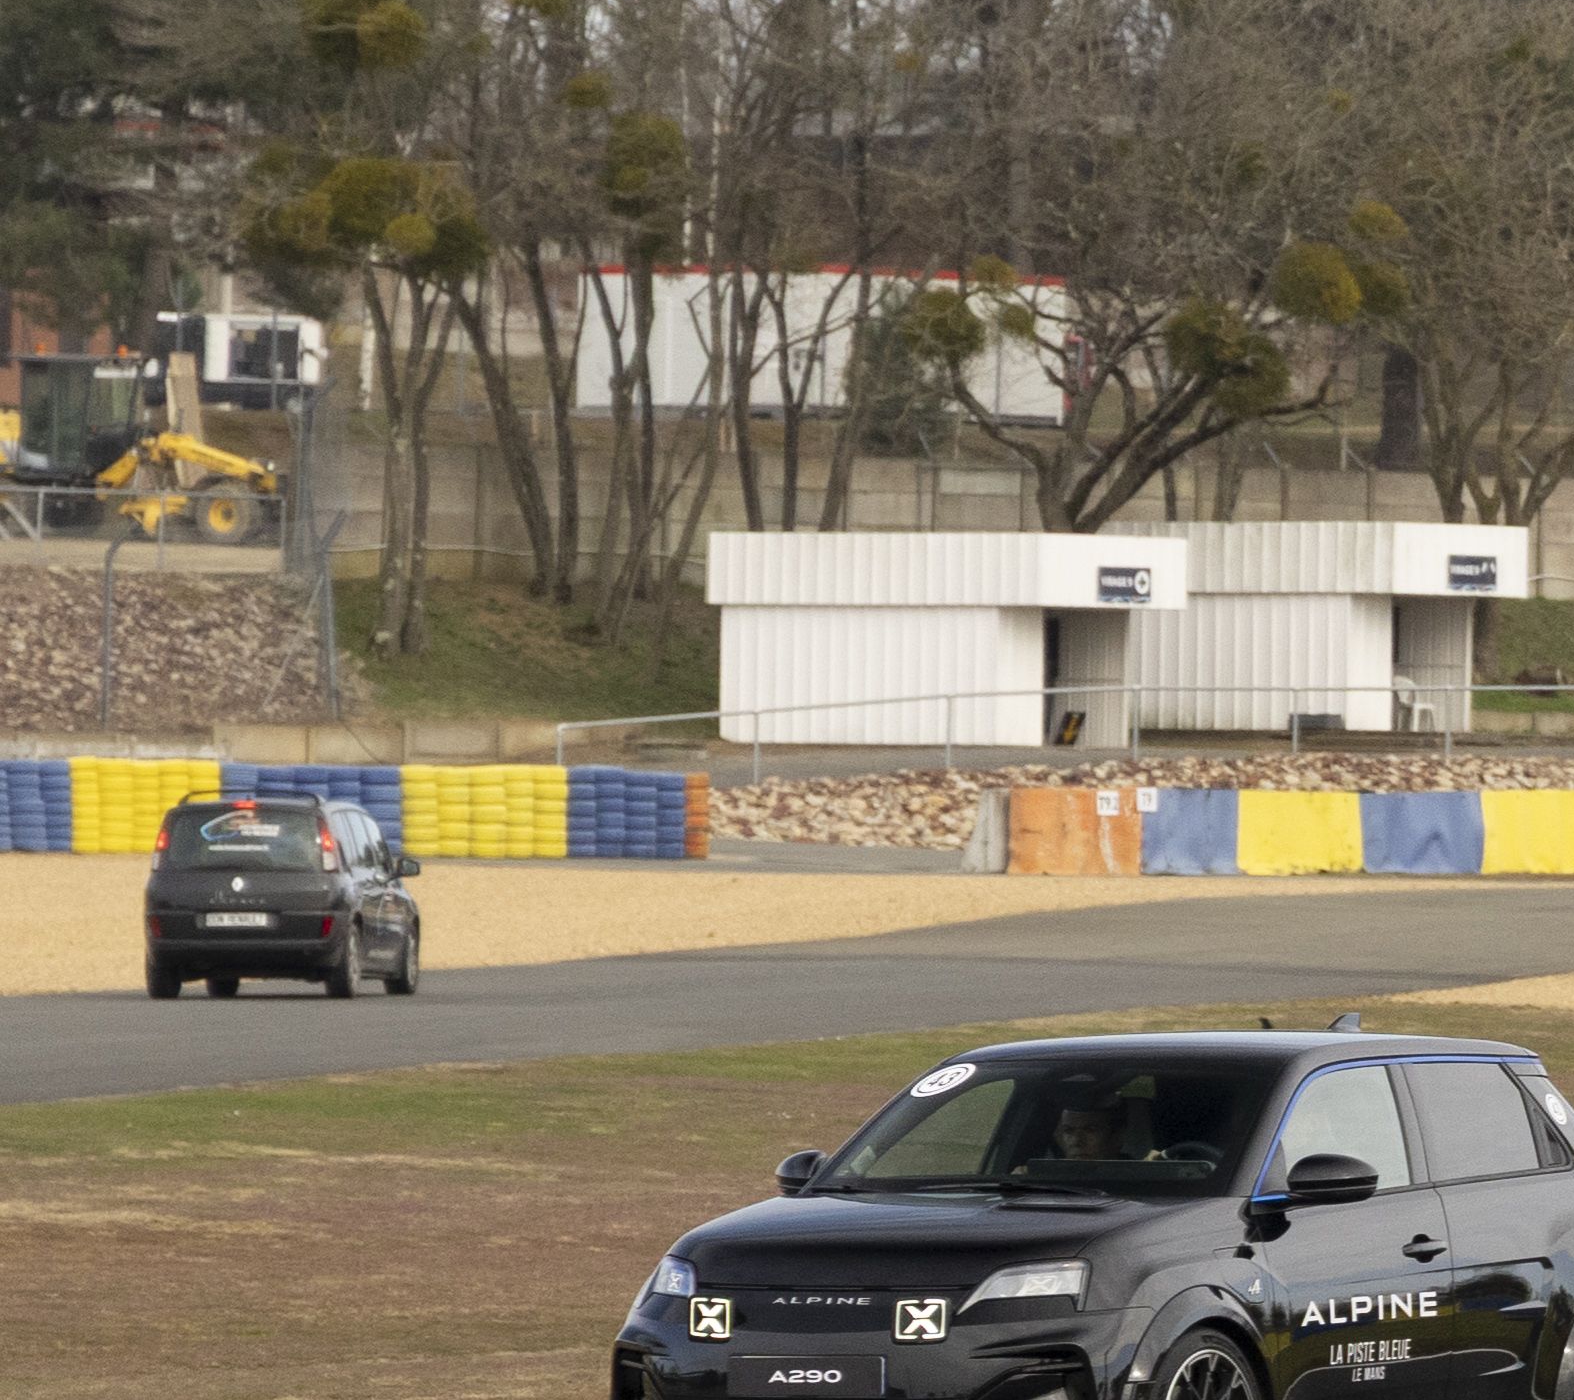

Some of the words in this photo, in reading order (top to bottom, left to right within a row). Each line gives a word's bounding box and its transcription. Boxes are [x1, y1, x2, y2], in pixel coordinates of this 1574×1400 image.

[927, 1071, 962, 1087] 43
[772, 1296, 871, 1306] ALPINE
[1300, 1290, 1438, 1327] ALPINE
[1329, 1344, 1343, 1365] LA
[1346, 1341, 1376, 1364] PISTE
[1378, 1338, 1412, 1361] BLEUE
[768, 1369, 842, 1383] A290
[1351, 1367, 1363, 1383] LE
[1363, 1366, 1386, 1381] MANS
